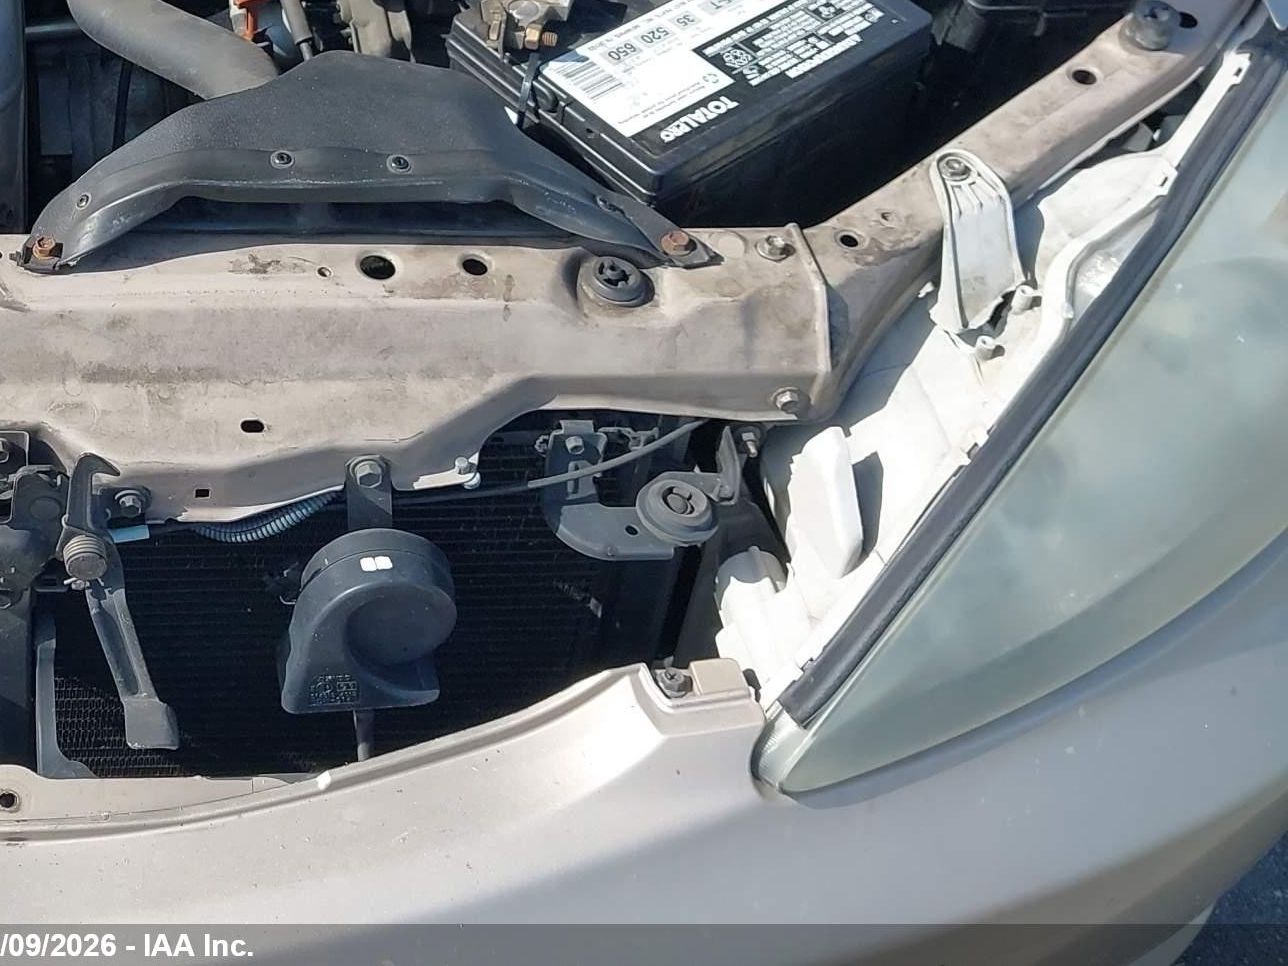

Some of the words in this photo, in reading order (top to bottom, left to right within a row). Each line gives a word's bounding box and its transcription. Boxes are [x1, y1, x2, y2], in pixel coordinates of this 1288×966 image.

[676, 13, 696, 27] 35
[640, 26, 670, 44] 520
[607, 42, 637, 62] 650
[660, 95, 740, 144] TOTALPRO
